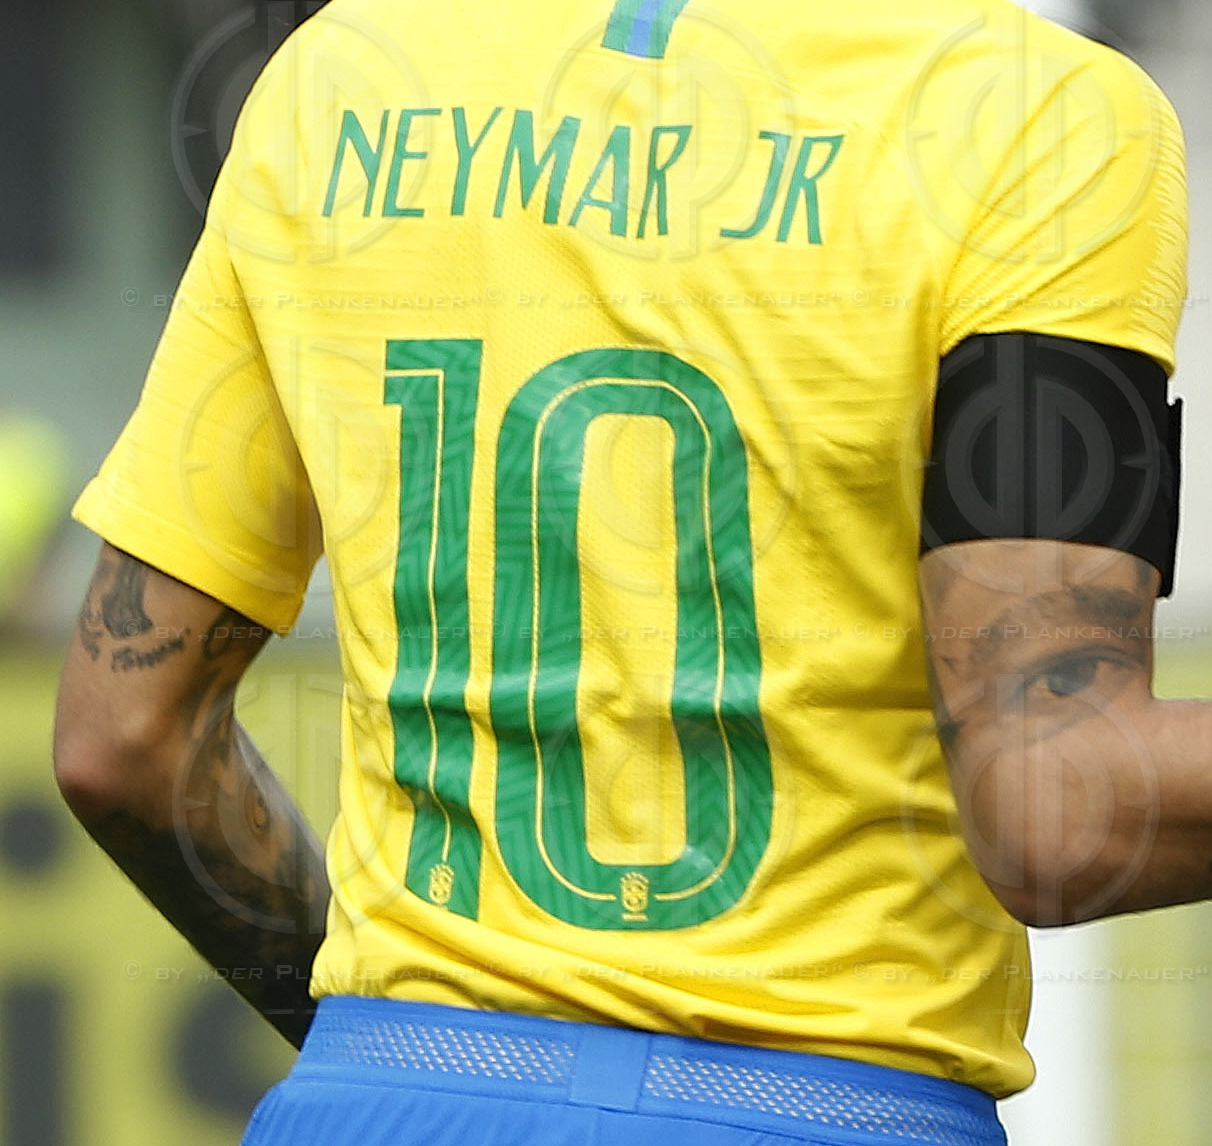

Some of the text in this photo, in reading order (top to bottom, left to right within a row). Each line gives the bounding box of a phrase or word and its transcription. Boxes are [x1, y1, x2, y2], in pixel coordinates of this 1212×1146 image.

[322, 106, 844, 246] NEYMAR JR
[382, 338, 774, 932] 10
